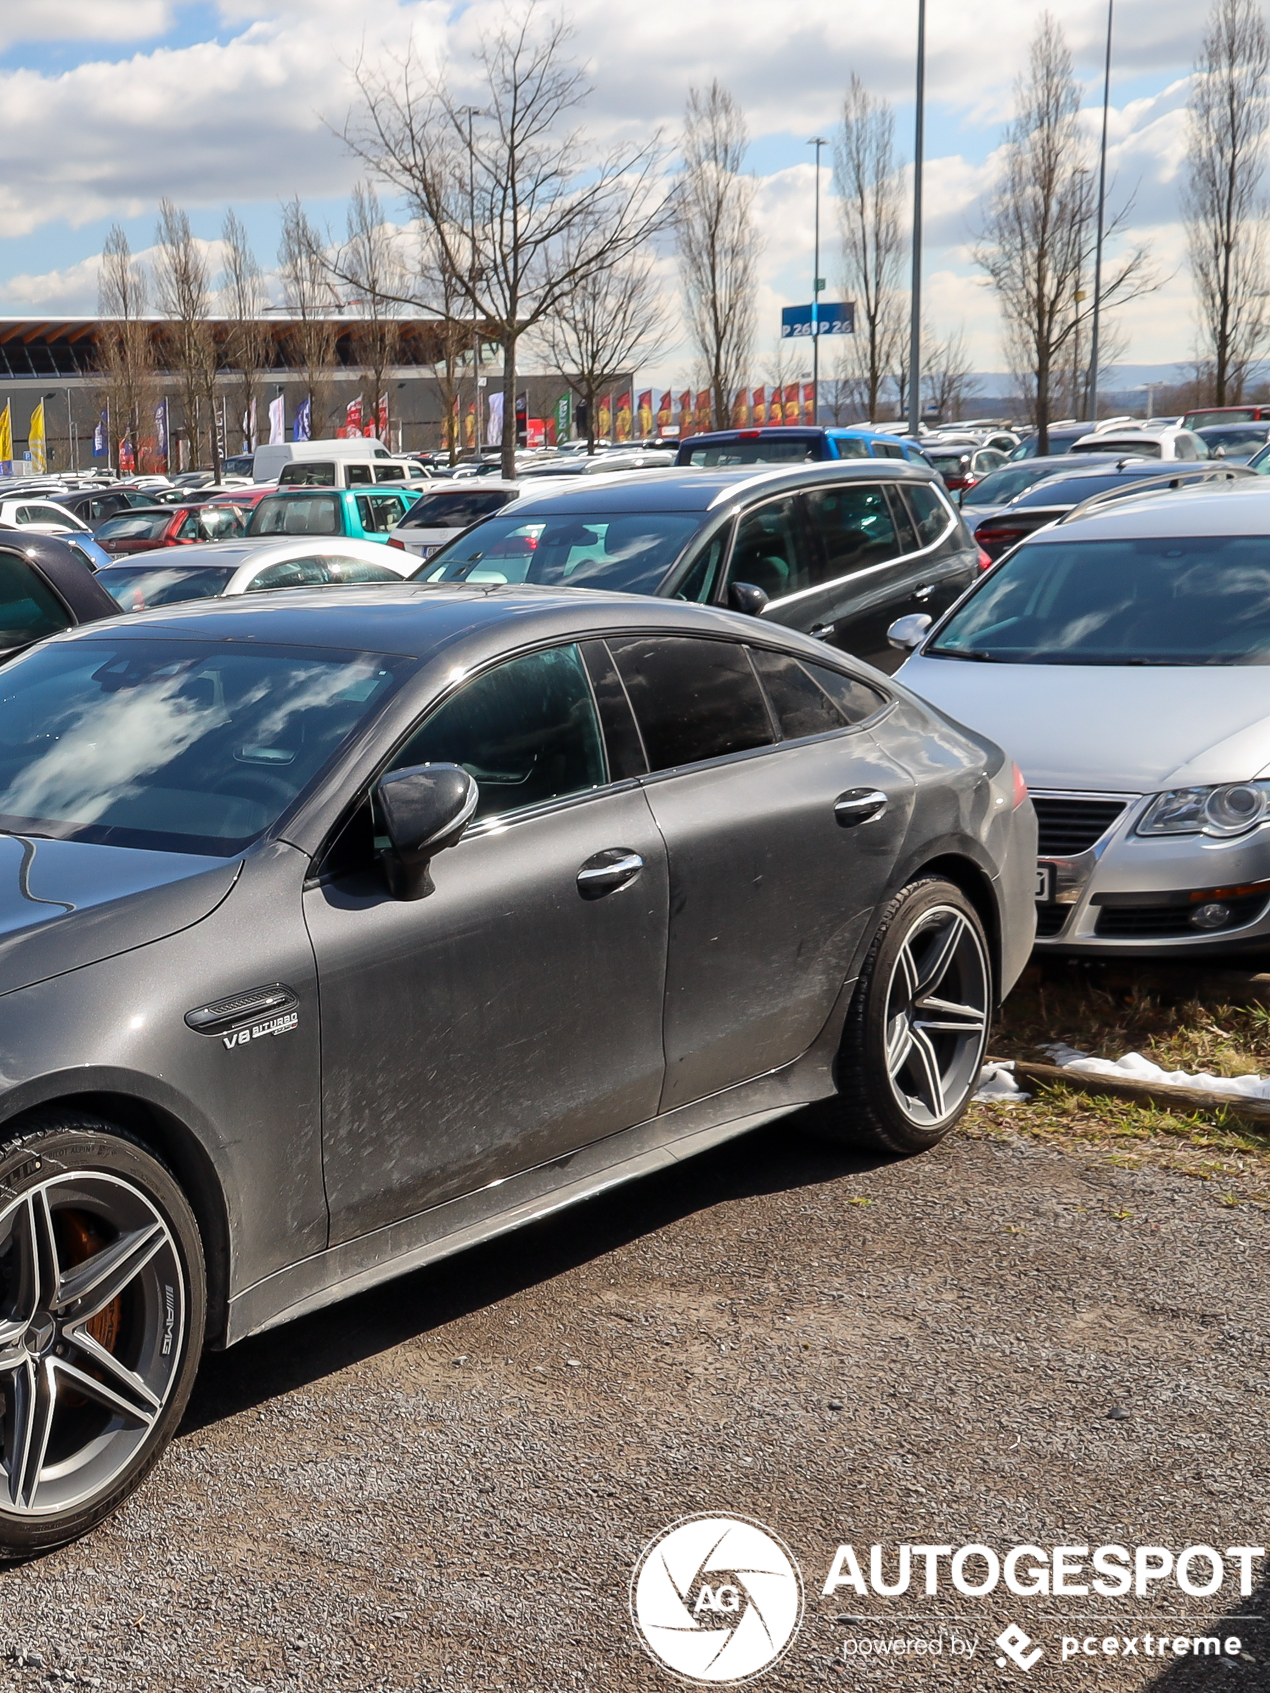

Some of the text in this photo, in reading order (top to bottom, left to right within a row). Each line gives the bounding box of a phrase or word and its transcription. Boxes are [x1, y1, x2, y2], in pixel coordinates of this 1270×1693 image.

[782, 323, 811, 337] P 26
[820, 321, 851, 334] P 26
[252, 1012, 298, 1034] BITURBO
[223, 1029, 250, 1049] V8
[161, 1303, 174, 1355] AMG
